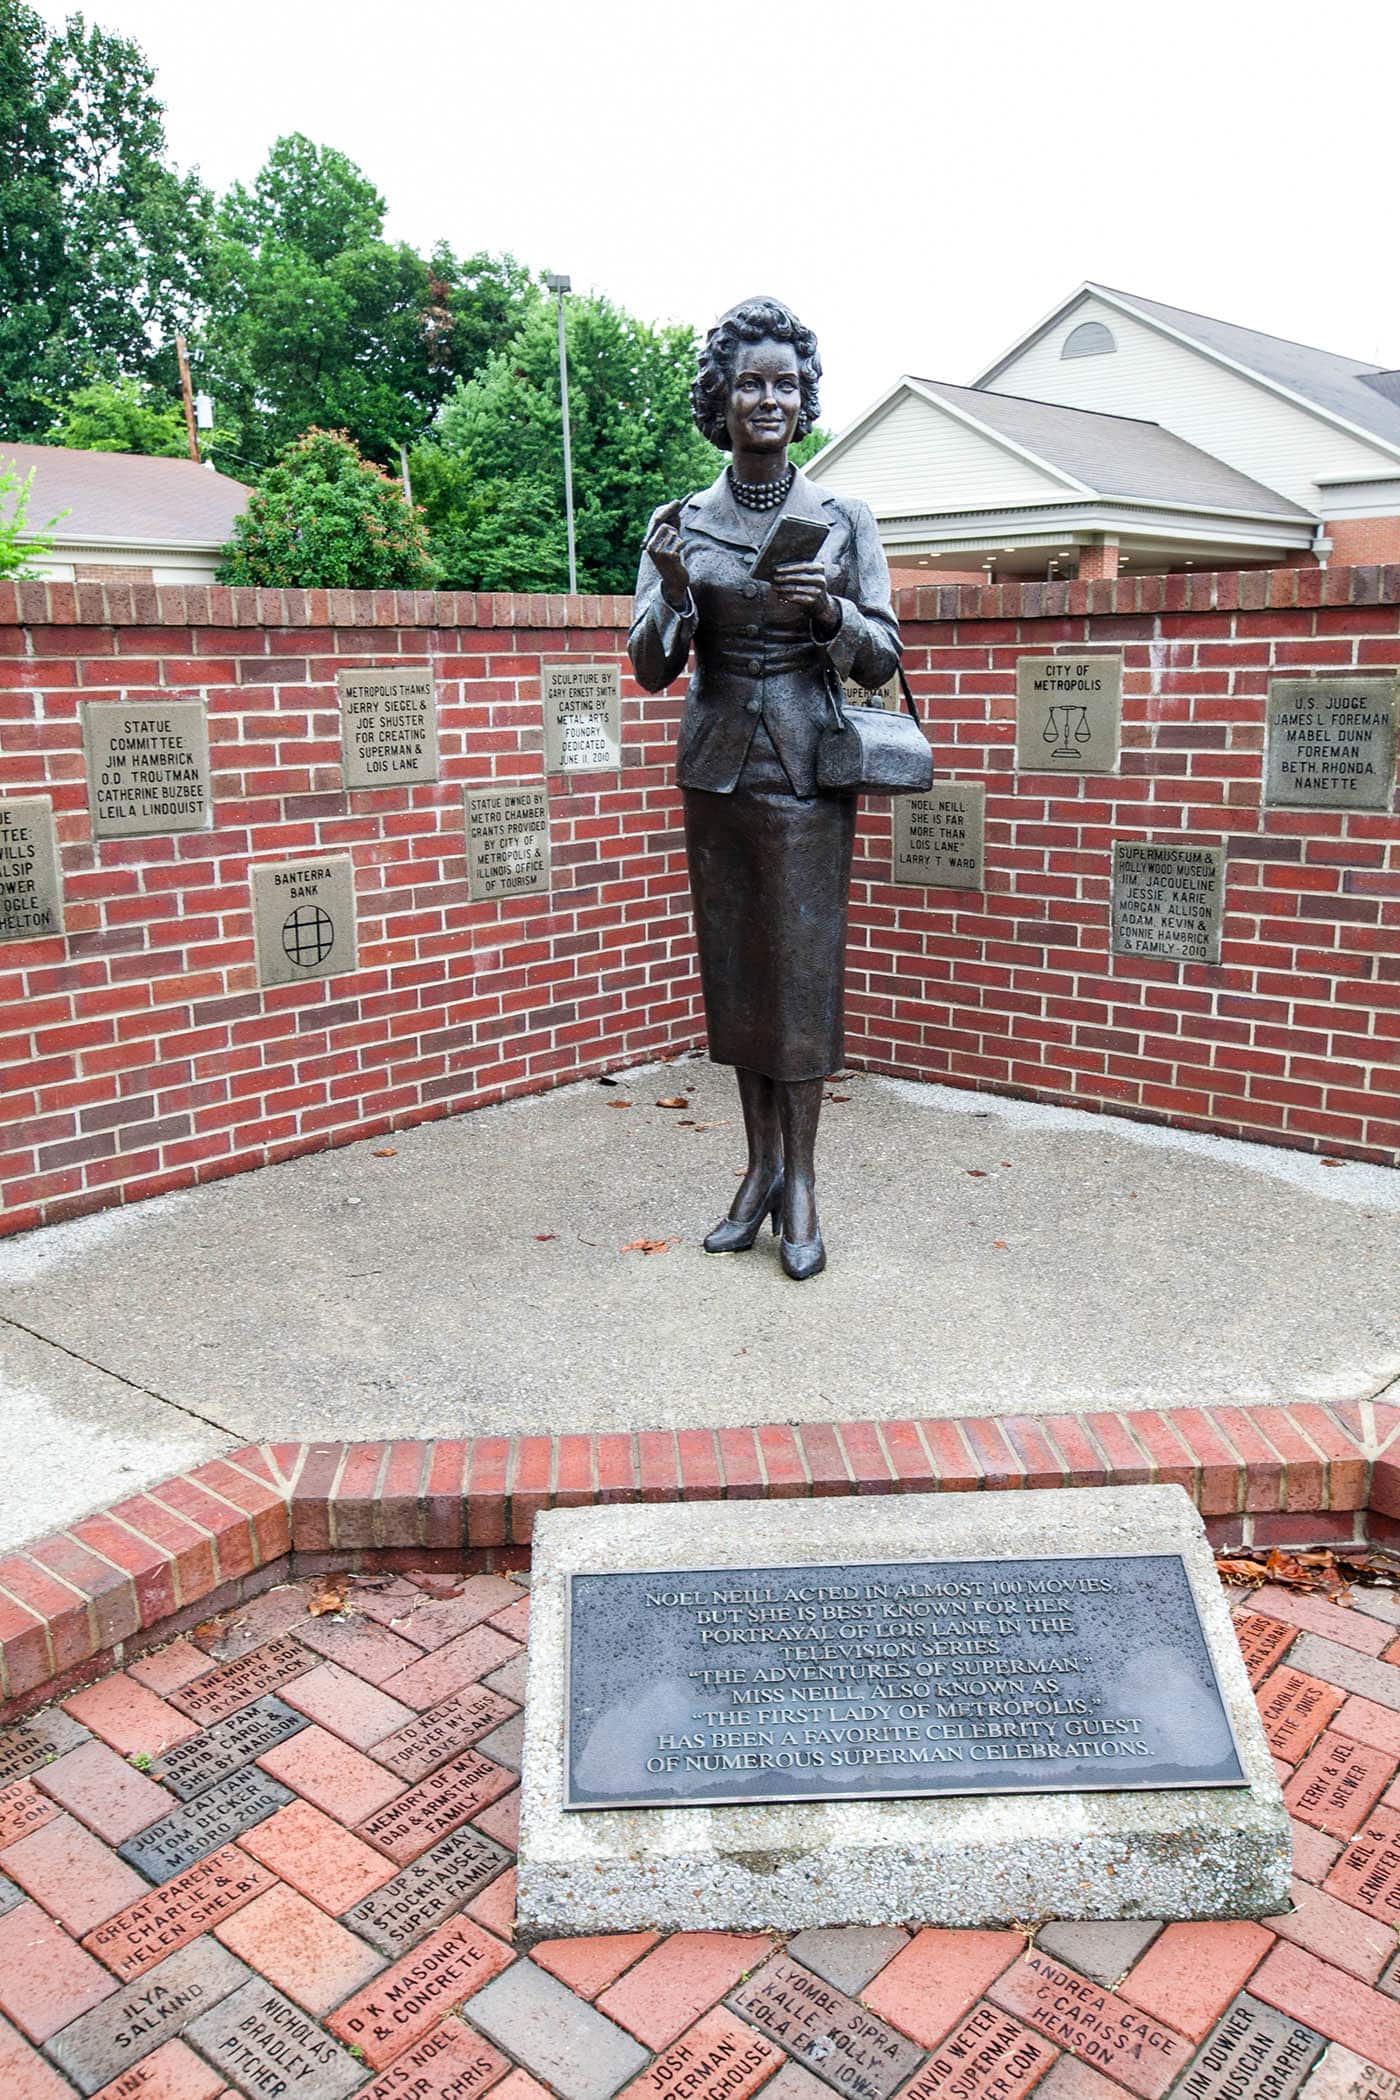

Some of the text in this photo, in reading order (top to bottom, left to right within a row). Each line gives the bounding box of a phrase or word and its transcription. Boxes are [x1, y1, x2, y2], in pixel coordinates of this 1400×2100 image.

[552, 674, 612, 685] SCULPTURE BY
[1046, 665, 1090, 676] CITY OF
[346, 684, 430, 697] METROPOLIS THANKS
[548, 687, 616, 698] GARY ERNEST SMITH
[1034, 680, 1101, 690] METROPOLIS
[348, 700, 426, 714] JERRY SIEGEL &
[559, 700, 606, 711] CASTING BY
[1326, 697, 1367, 709] JUDGE
[124, 721, 172, 733] STATUE
[357, 715, 424, 729] JOE SHUSTER
[557, 713, 609, 725] METAL ARTS
[356, 729, 425, 743] FOR CREATING
[566, 727, 600, 737] FOUNDRY
[1287, 730, 1372, 741] MABEL DUNN
[359, 744, 422, 758] SUPERMAN &
[562, 739, 605, 751] DEDICATED
[1297, 746, 1360, 758] FOREMAN
[106, 753, 194, 768] JIM HAMBRICK
[367, 759, 418, 772] LOIS LANE
[97, 785, 204, 802] CATHERINE BUZBEE
[1295, 778, 1357, 790] NANETTE
[100, 801, 204, 818] LEILA LINDQUIST
[471, 795, 543, 810] STATUE OWNED BY
[471, 808, 544, 823] METRO CHAMBER
[912, 813, 964, 825] SHE IS FAR
[472, 821, 545, 838] GRANTS PROVIDED
[910, 827, 965, 839] MORE THAN
[275, 869, 332, 885] BANTERRA
[477, 861, 544, 878] ILLINOIS OFFICE
[1120, 862, 1215, 877] HOLLYWOOD MUSEUM
[290, 885, 318, 898] BANK
[1120, 927, 1209, 944] CONNIE HAMBRICK
[646, 1592, 707, 1607] NOEL
[712, 1589, 778, 1605] NEILL
[784, 1586, 858, 1602] ACTED
[865, 1585, 887, 1599] IN
[895, 1582, 985, 1598] ALMOST
[991, 1581, 1021, 1595] 100
[696, 1599, 1073, 1625] BUT SHE IS BEST KNOWN FOR HER
[700, 1618, 1075, 1645] PORTRAYAL OF LOIS LANE IN THE
[780, 1639, 1000, 1662] TELEVISION SERIES
[179, 1640, 288, 1700] IN MEMORY OF
[190, 1647, 304, 1710] OUR SUPER SON
[752, 1662, 910, 1683] ADVENTURES
[915, 1662, 948, 1676] OF
[732, 1688, 785, 1705] MISS
[871, 1683, 930, 1700] ALSO
[936, 1680, 1030, 1696] KNOWN
[1031, 1679, 1059, 1694] AS
[396, 1698, 463, 1743] TO KELLY
[757, 1708, 823, 1724] FIRST
[829, 1706, 893, 1722] LADY
[899, 1704, 930, 1719] OF
[658, 1718, 1142, 1750] HAS BEEN A FAVORITE CELEBRITY GUEST
[179, 1717, 300, 1791] SHELBY MADISON
[647, 1740, 1155, 1773] OF NUMEROUS SUPERMAN CELEBRATIONS.
[366, 1753, 478, 1836] MEMORY OF MY
[1330, 1764, 1368, 1808] BREWER
[380, 1763, 495, 1846] DAD & ARMSTRONG
[425, 1793, 483, 1834] FAMILY
[153, 1785, 261, 1855] TOM DECKER
[373, 1841, 490, 1930] STOCKHAUSEN
[95, 1851, 235, 1945] GREAT PARENTS
[389, 1853, 502, 1941] SUPER FAMILY
[127, 1875, 233, 1944] CHARLIE &
[122, 1873, 262, 1972] HELEN SHELBY
[122, 1985, 170, 2019] ILYA
[373, 1947, 485, 2041] & CONCRETE
[114, 1983, 203, 2048] SALKIND
[1029, 1959, 1176, 2056] ANDREA GAGE
[262, 1997, 337, 2064] NICHOLAS
[1032, 2007, 1114, 2065] HENSON
[239, 2016, 314, 2080] BRADLEY
[411, 2031, 458, 2067] NOEL
[908, 2009, 998, 2100] DAVID WETER
[219, 2037, 287, 2099] PITCHER
[650, 2045, 694, 2090] JOSH
[950, 2022, 1022, 2099] SUPERMAN
